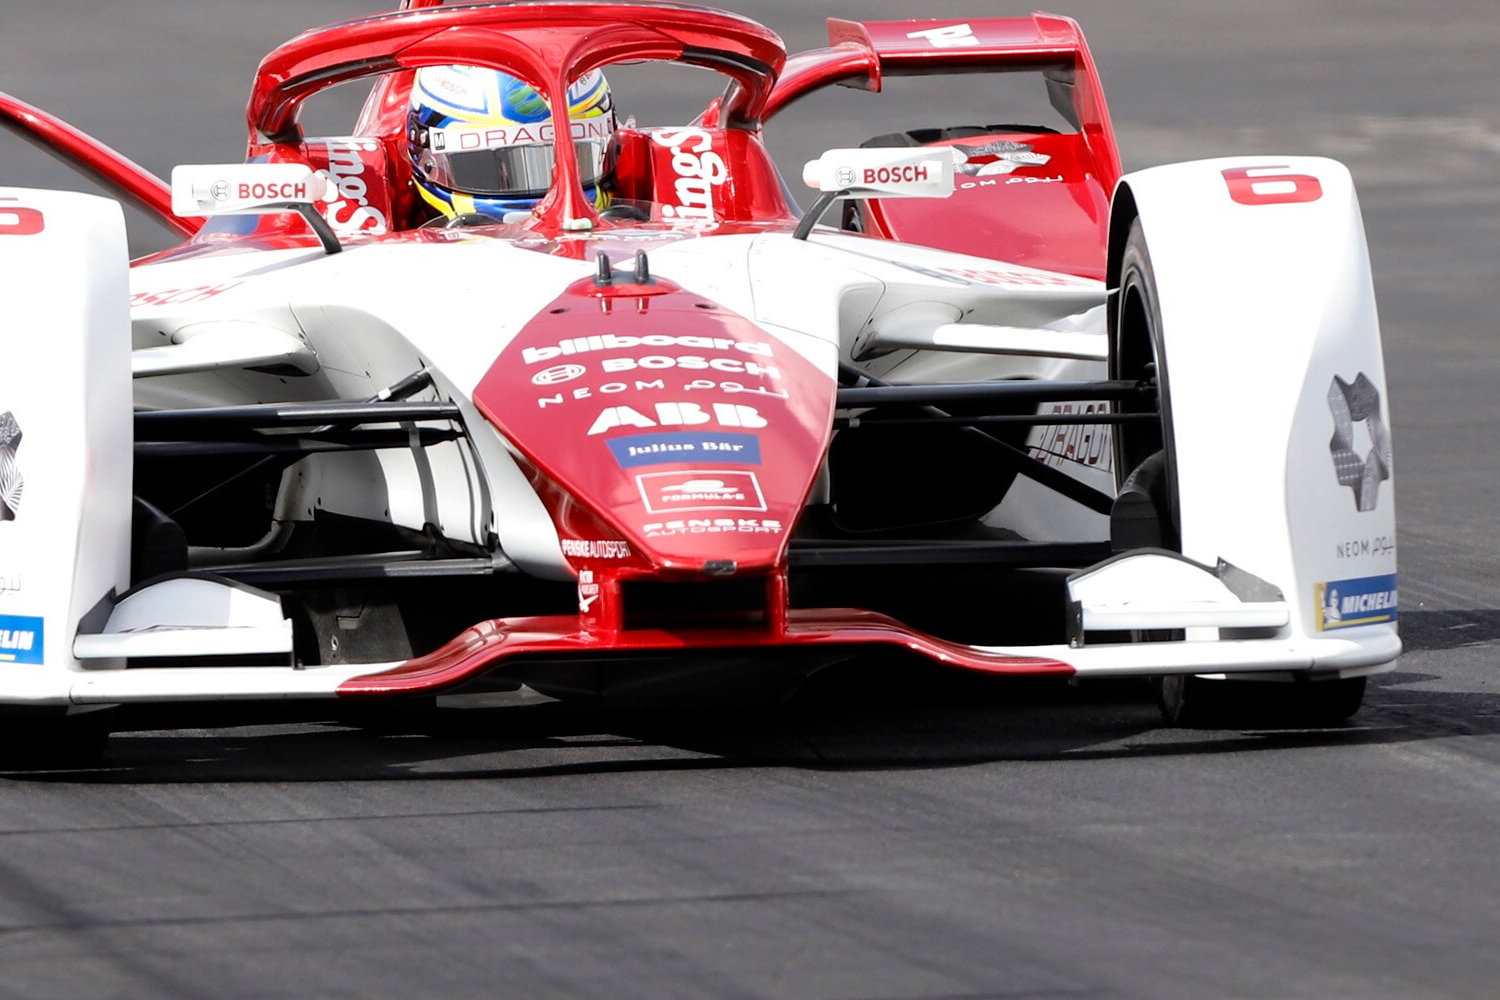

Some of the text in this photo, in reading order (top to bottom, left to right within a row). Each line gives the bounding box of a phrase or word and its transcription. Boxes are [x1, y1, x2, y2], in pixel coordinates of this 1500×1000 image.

[863, 165, 929, 184] BOSCH
[238, 183, 306, 199] BOSCH
[1220, 165, 1323, 206] 6
[522, 334, 774, 364] billboard
[602, 356, 781, 379] BOSCH
[537, 379, 665, 409] NEOM
[587, 402, 768, 435] ABB
[628, 441, 744, 456] Julius Bär
[643, 519, 782, 532] PENSKE
[646, 527, 784, 537] AUTOSPORT
[561, 539, 632, 559] PENSKE AUTOSPORT
[1337, 540, 1369, 558] NEOM
